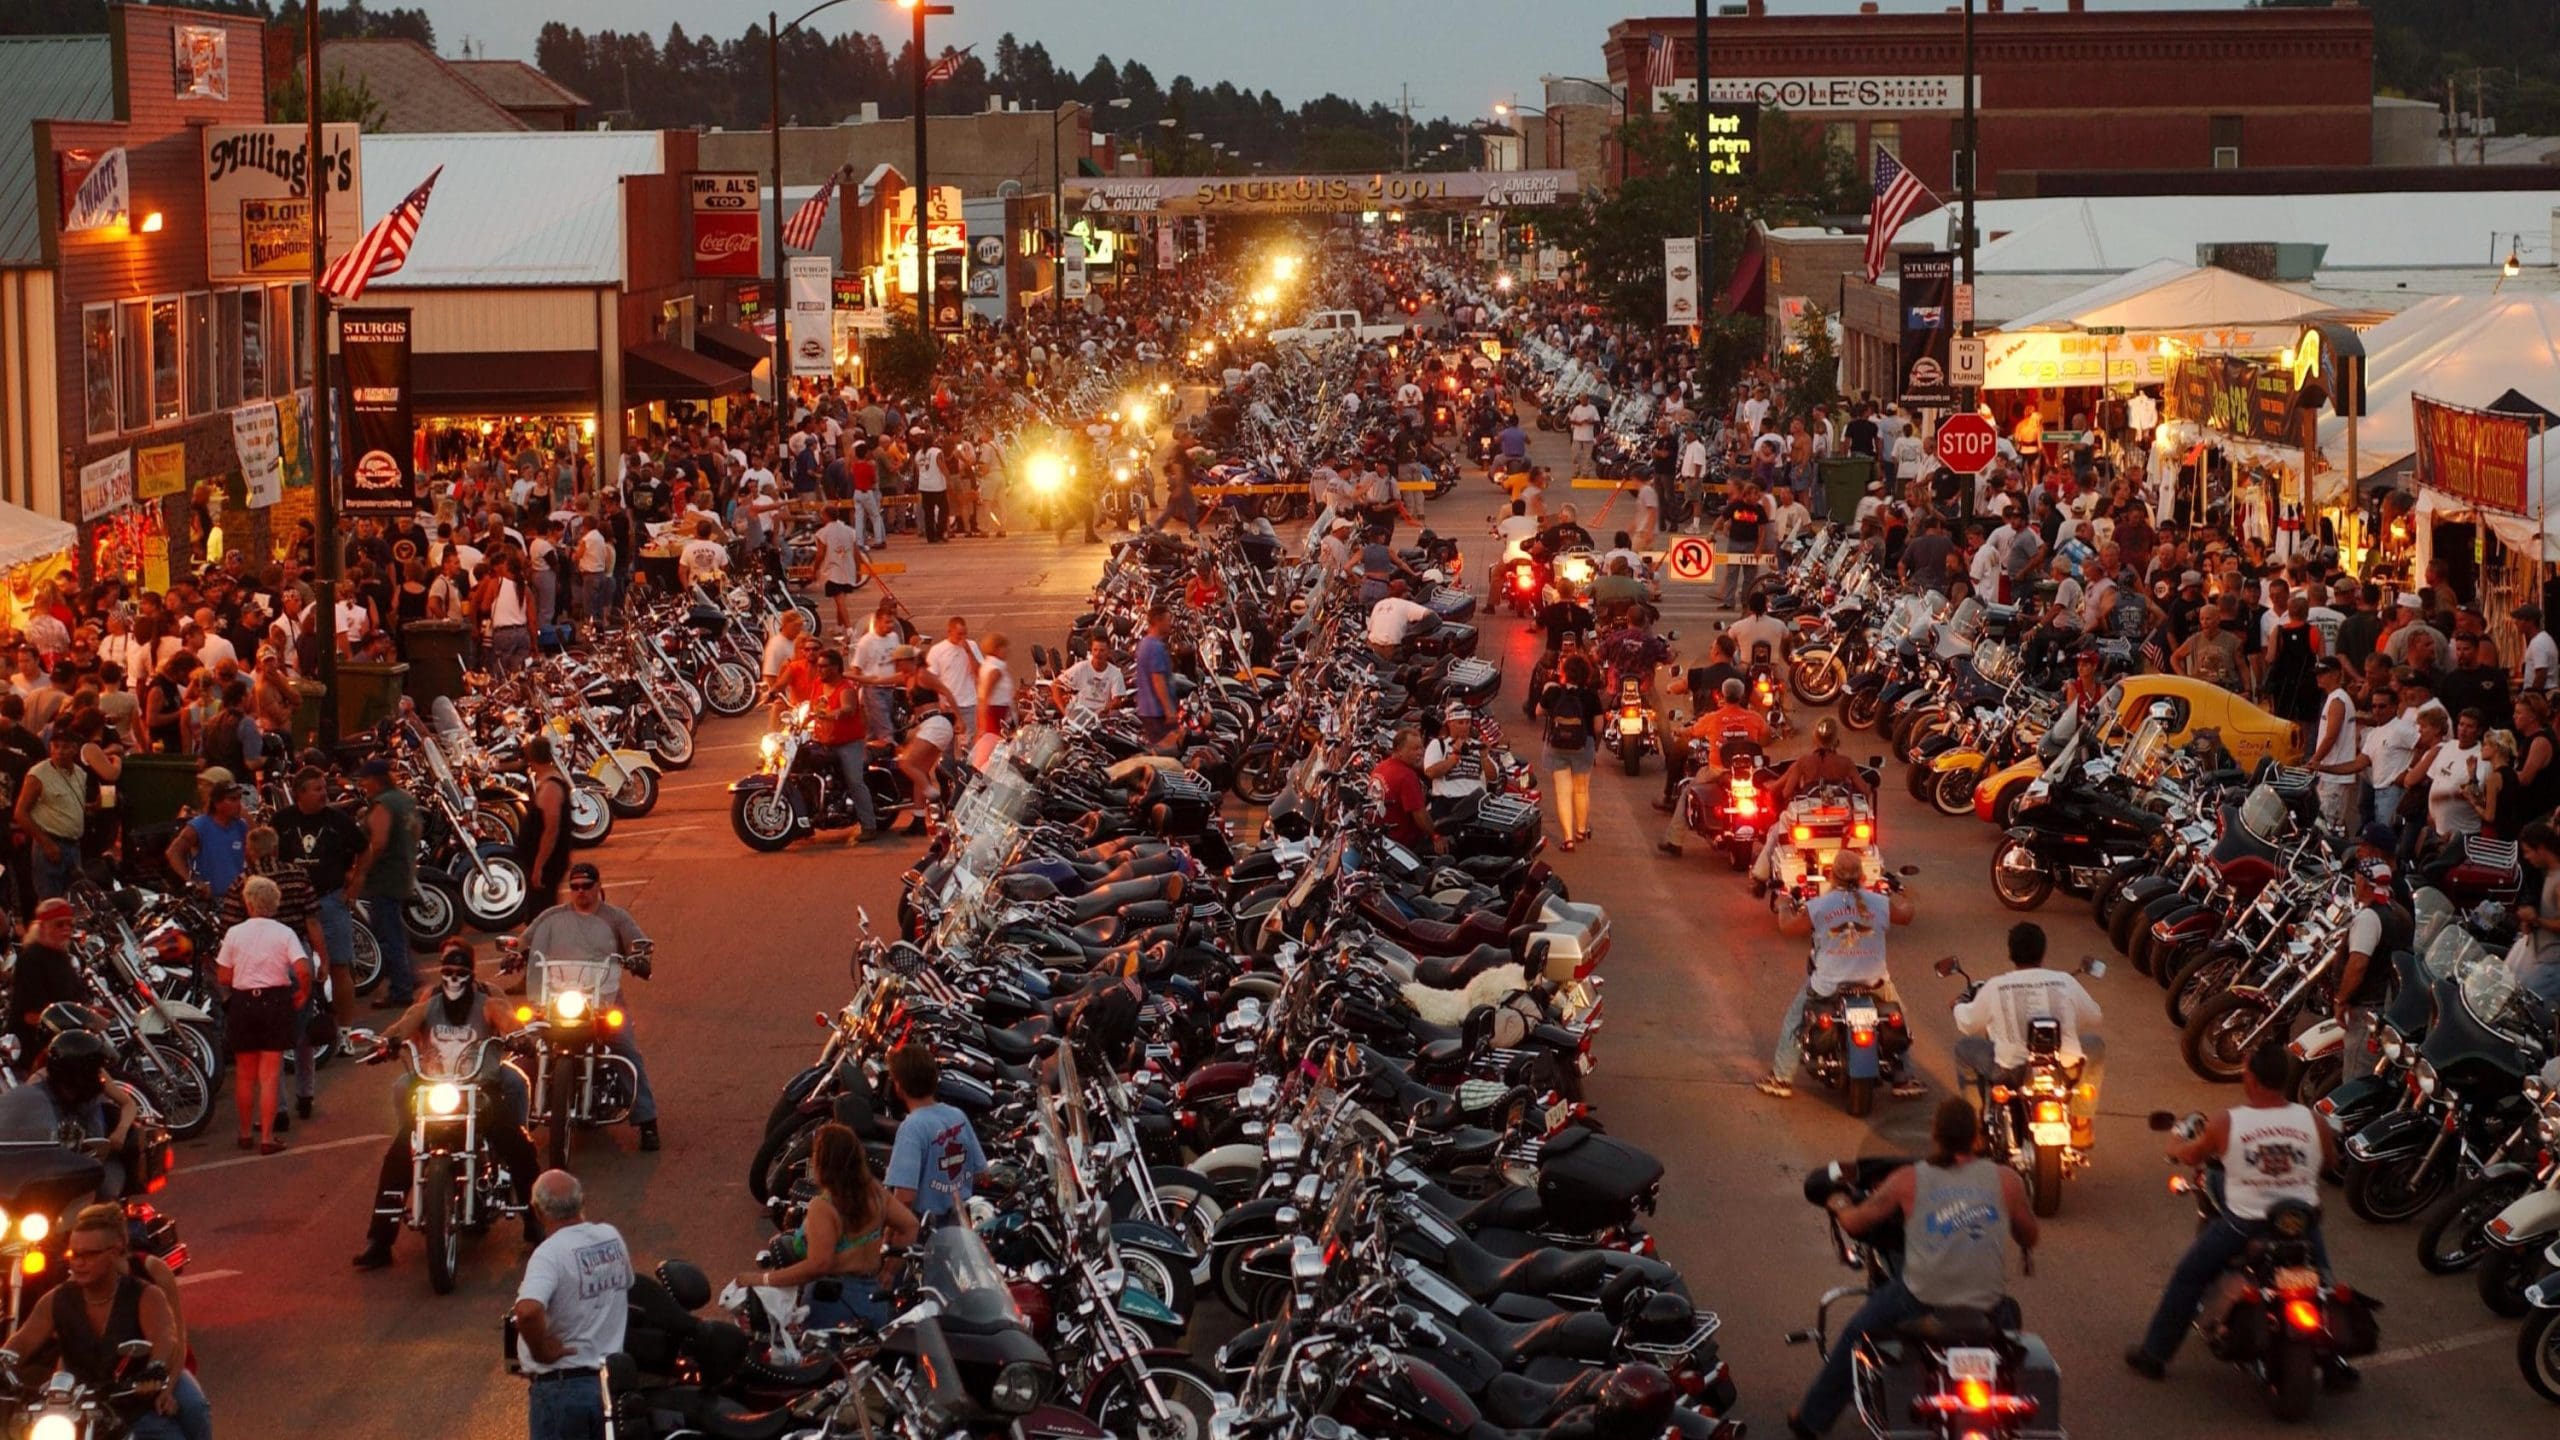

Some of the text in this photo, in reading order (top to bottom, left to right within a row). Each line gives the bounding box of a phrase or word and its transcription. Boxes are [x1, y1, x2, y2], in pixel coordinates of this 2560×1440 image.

[1687, 89, 1767, 101] AERICAN
[1884, 88, 1948, 100] MUSEUM
[1754, 80, 1880, 107] COLE'S
[210, 133, 352, 198] Millingr's
[694, 179, 757, 193] MR. AL'S
[1197, 174, 1447, 205] STURGIS 2001
[1504, 176, 1560, 191] AMERICA
[1105, 184, 1160, 199] AMERICA
[1512, 191, 1557, 205] ONLINE
[711, 198, 741, 206] TOO
[1113, 199, 1158, 211] ONLINE
[1903, 262, 1951, 273] STURGIS
[343, 322, 407, 334] STURGIS
[1958, 344, 1975, 352] NO
[1961, 356, 1973, 371] U
[1953, 372, 1983, 381] TURNS
[1942, 432, 1993, 454] STOP
